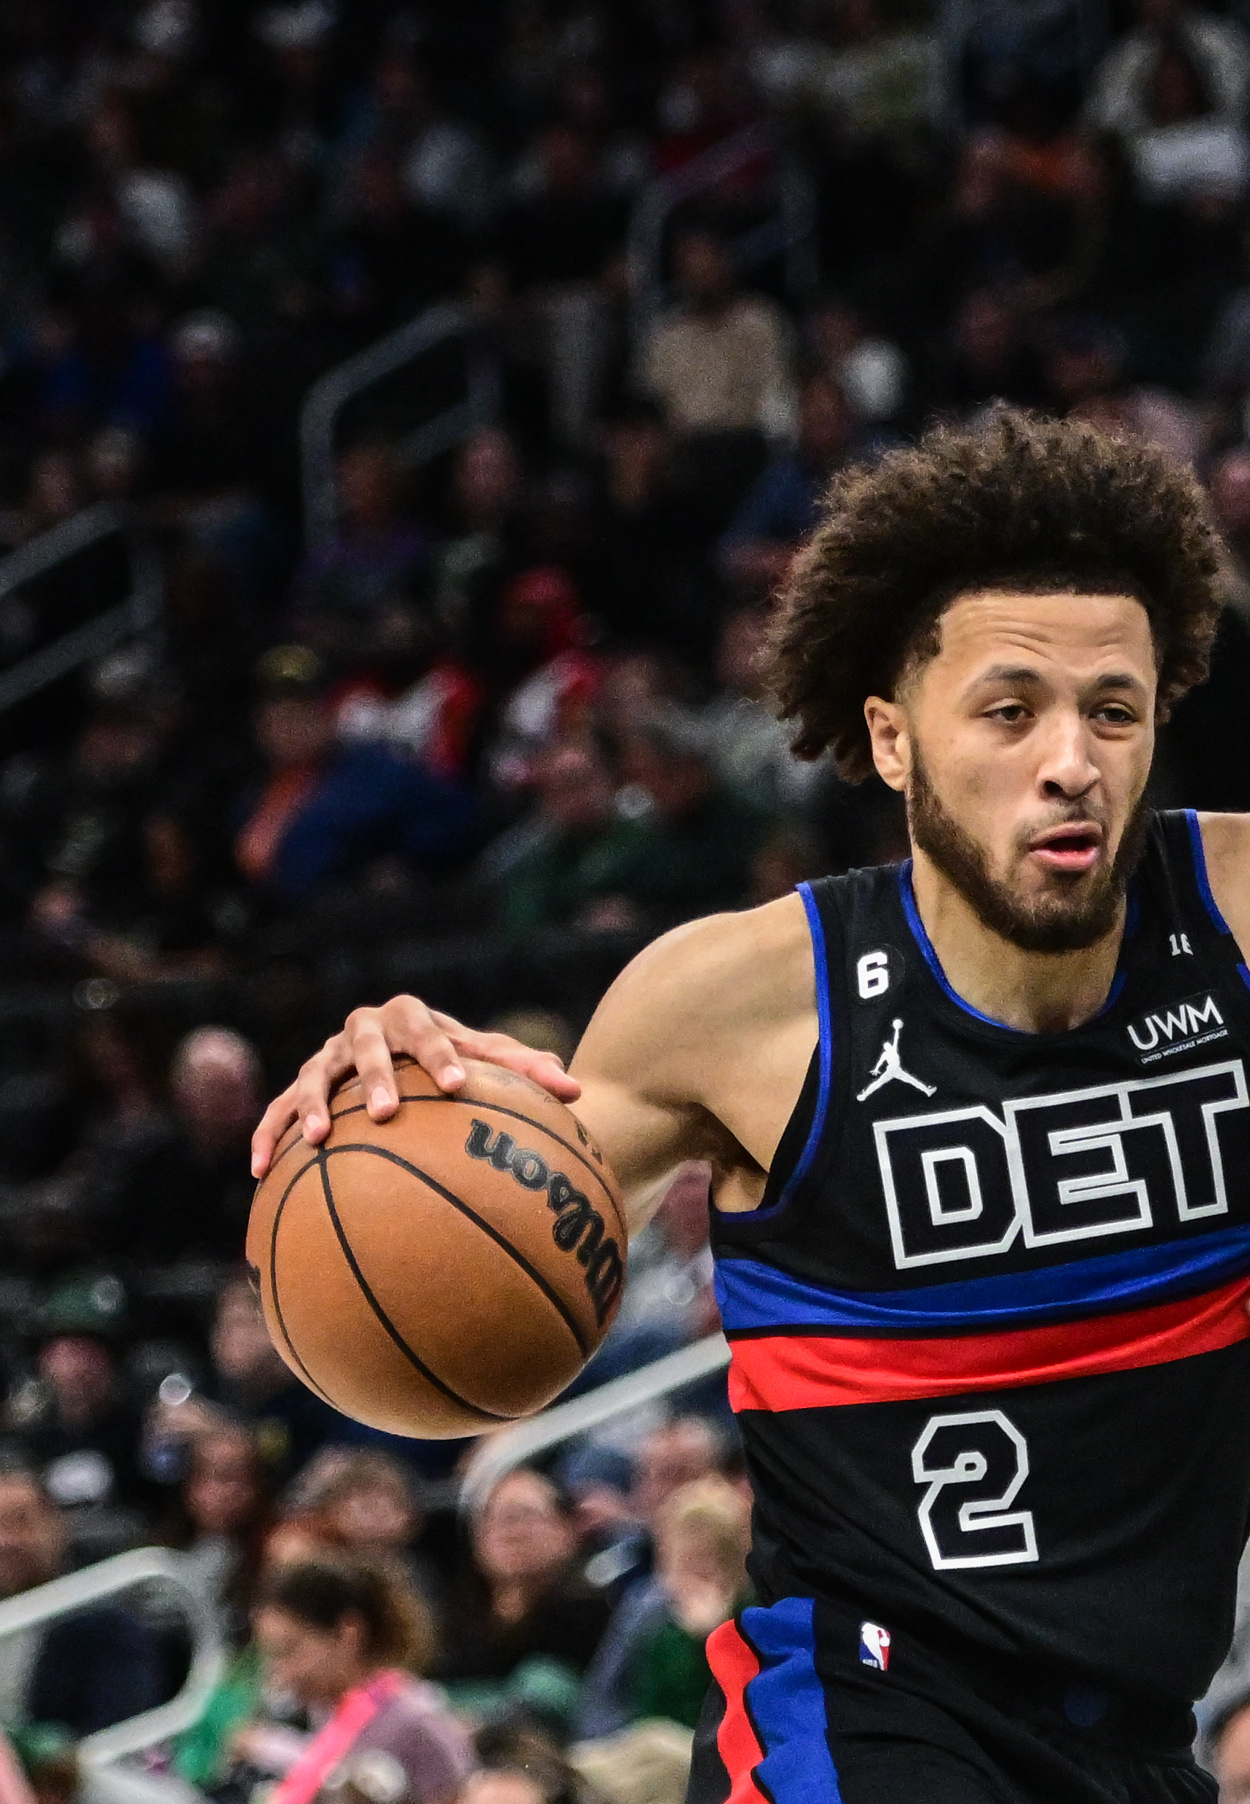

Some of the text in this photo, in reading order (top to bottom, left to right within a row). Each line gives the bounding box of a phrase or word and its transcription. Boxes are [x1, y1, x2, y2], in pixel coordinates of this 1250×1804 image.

[857, 951, 889, 999] 6
[1126, 995, 1225, 1051] UWM
[1141, 1053, 1162, 1064] UNITED
[1162, 1041, 1195, 1057] WHOLESALE
[872, 1058, 1250, 1270] DET
[911, 1409, 1040, 1571] 2
